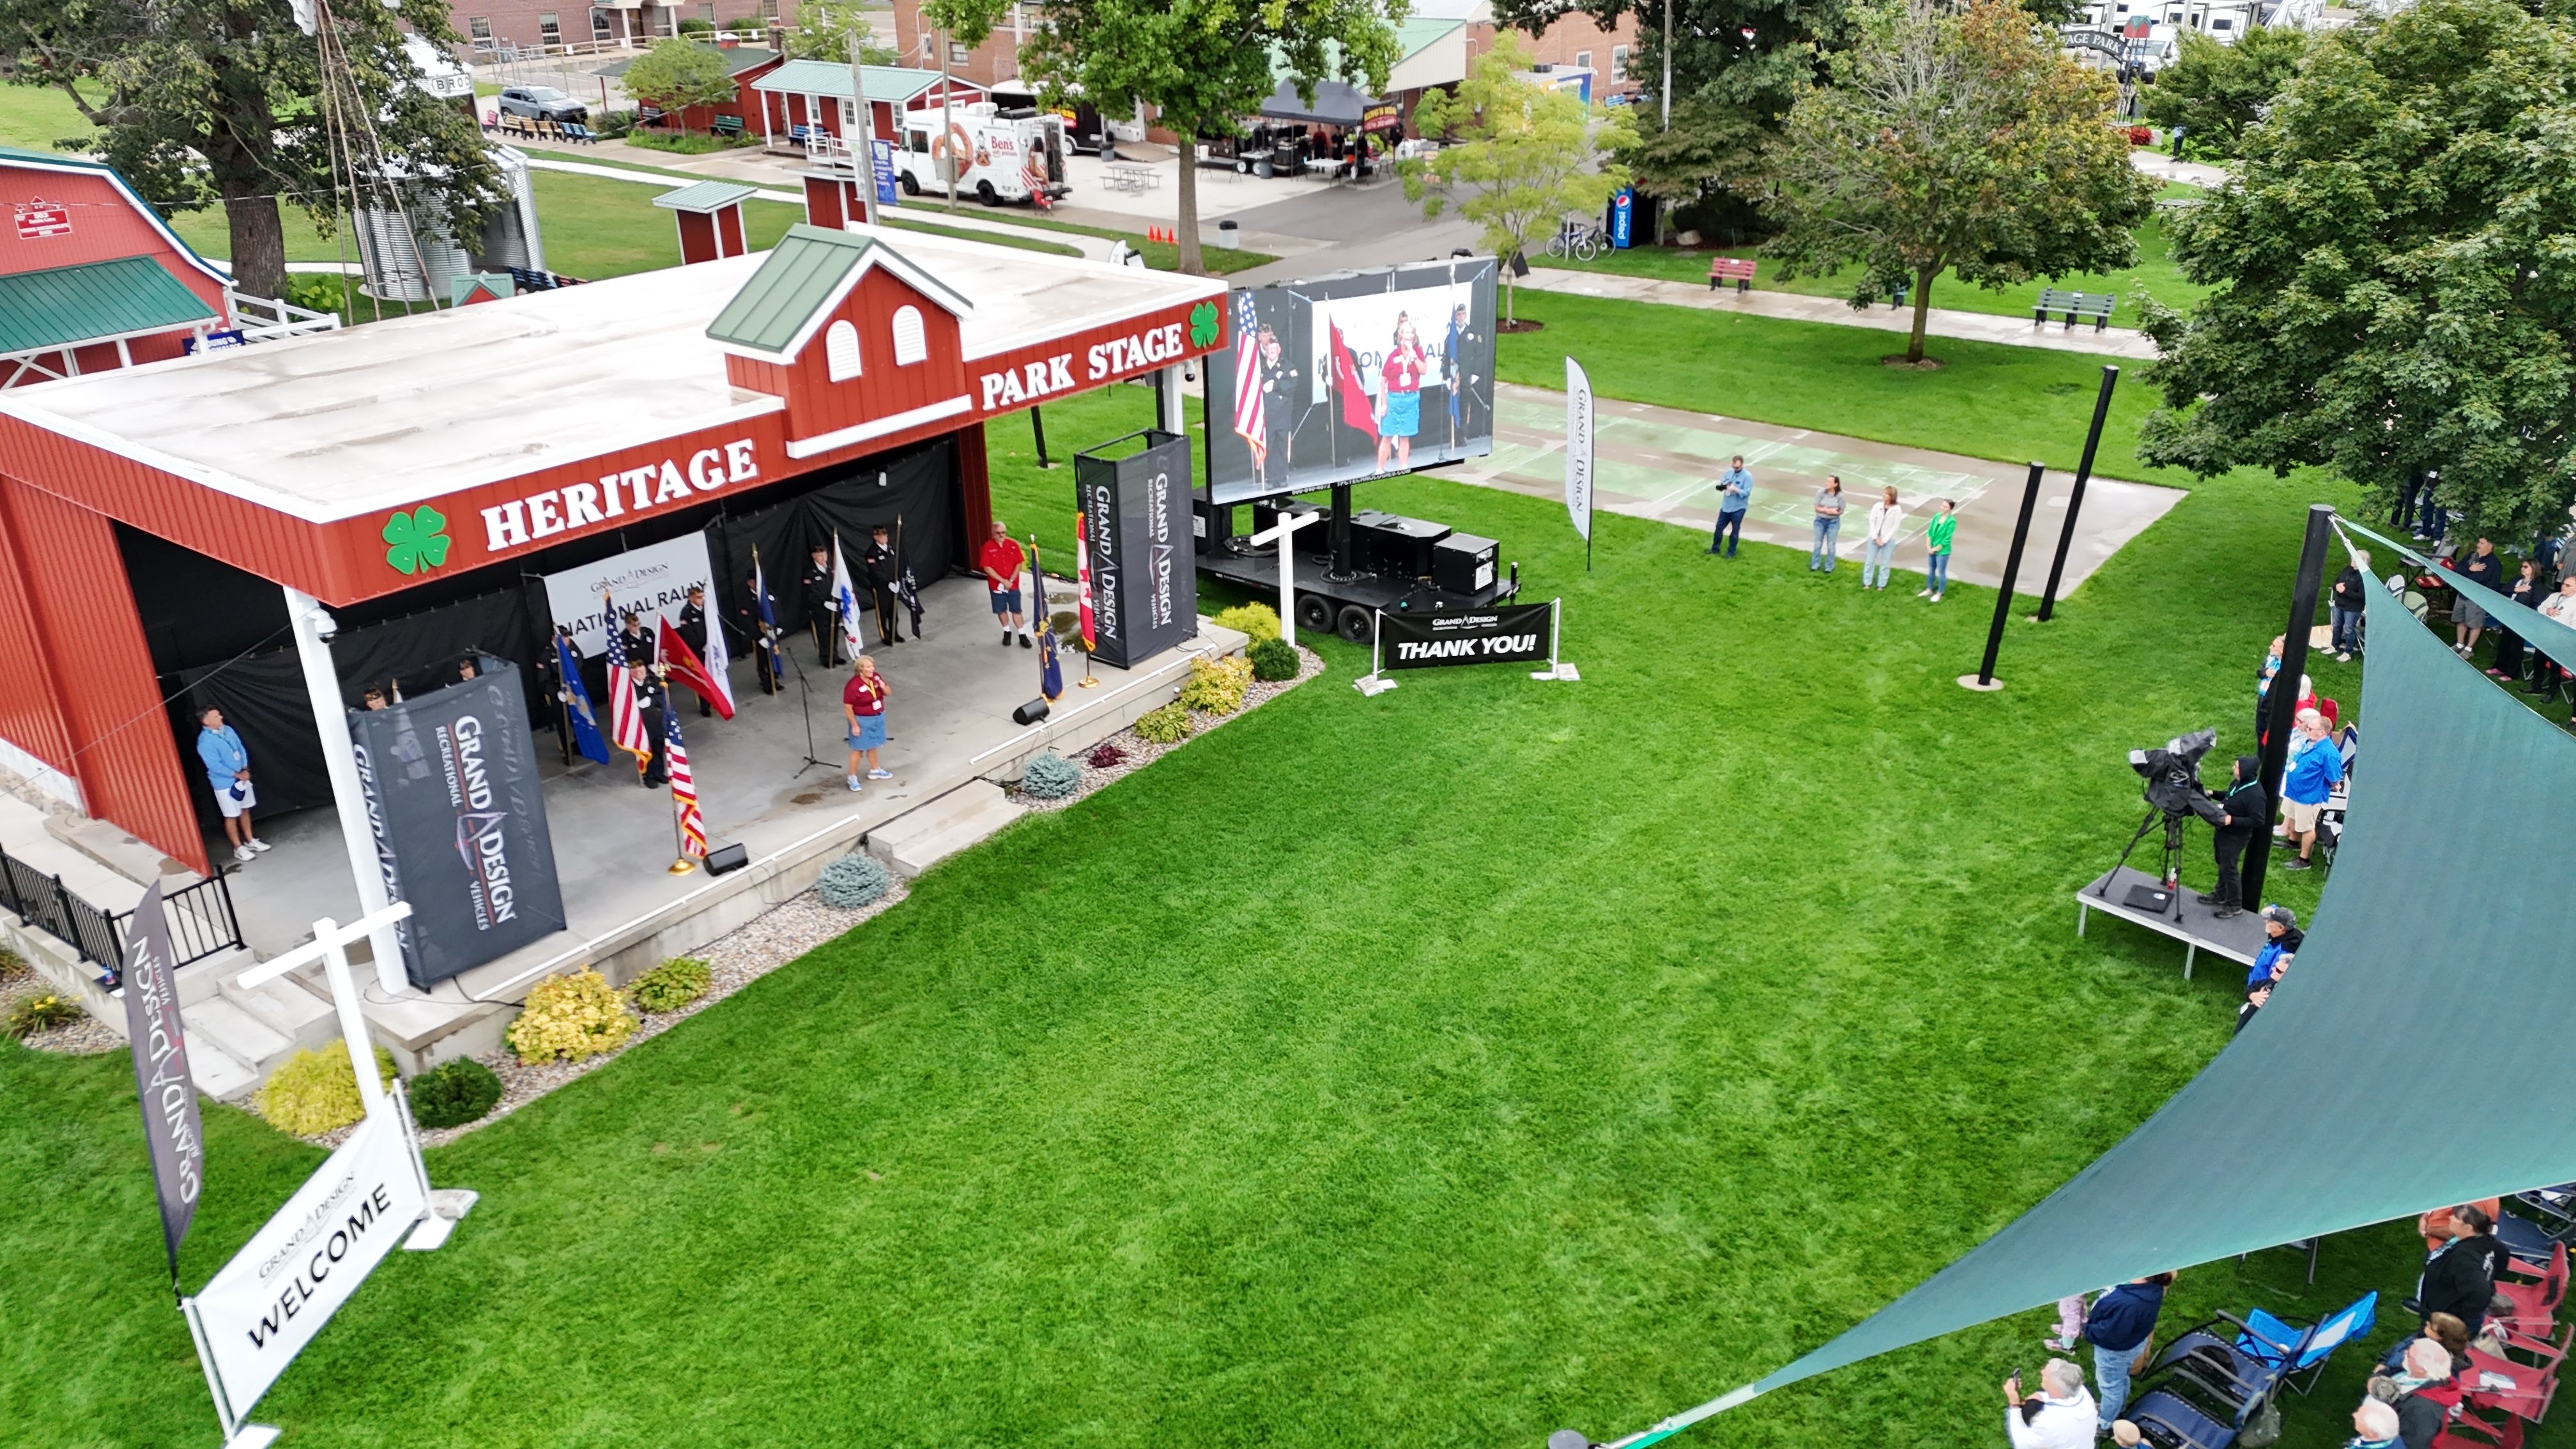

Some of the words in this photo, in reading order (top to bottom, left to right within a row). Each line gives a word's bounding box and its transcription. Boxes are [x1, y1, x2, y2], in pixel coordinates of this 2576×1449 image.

[2092, 34, 2122, 54] PARK
[1617, 211, 1627, 240] pepsi
[480, 438, 759, 551] HERITAGE
[980, 353, 1075, 411] PARK
[1088, 323, 1183, 380] STAGE
[1577, 388, 1587, 444] GRAND
[1154, 472, 1169, 543] GRAND
[1575, 459, 1585, 512] DESIGN
[1096, 485, 1112, 556] GRAND
[634, 562, 670, 579] DESIGN
[1158, 558, 1172, 626] DESIGN
[563, 595, 654, 636] NATINAL
[1101, 572, 1117, 641] DESIGN
[1469, 615, 1498, 624] DESIGN
[1398, 638, 1478, 660] THANK
[1481, 634, 1537, 654] YOU!
[353, 743, 385, 838] GRAND
[455, 714, 493, 809] GRAND
[478, 828, 519, 925] DESIGN
[434, 725, 464, 808] RECREATIONAL
[468, 880, 491, 931] VEHICLES
[132, 935, 171, 1064] DESIGN
[152, 955, 171, 1006] VEHICLES
[162, 1084, 199, 1205] GRAND
[258, 1227, 305, 1280] GRAND
[314, 1170, 356, 1220] DESIGN
[246, 1183, 391, 1351] WELCOME
